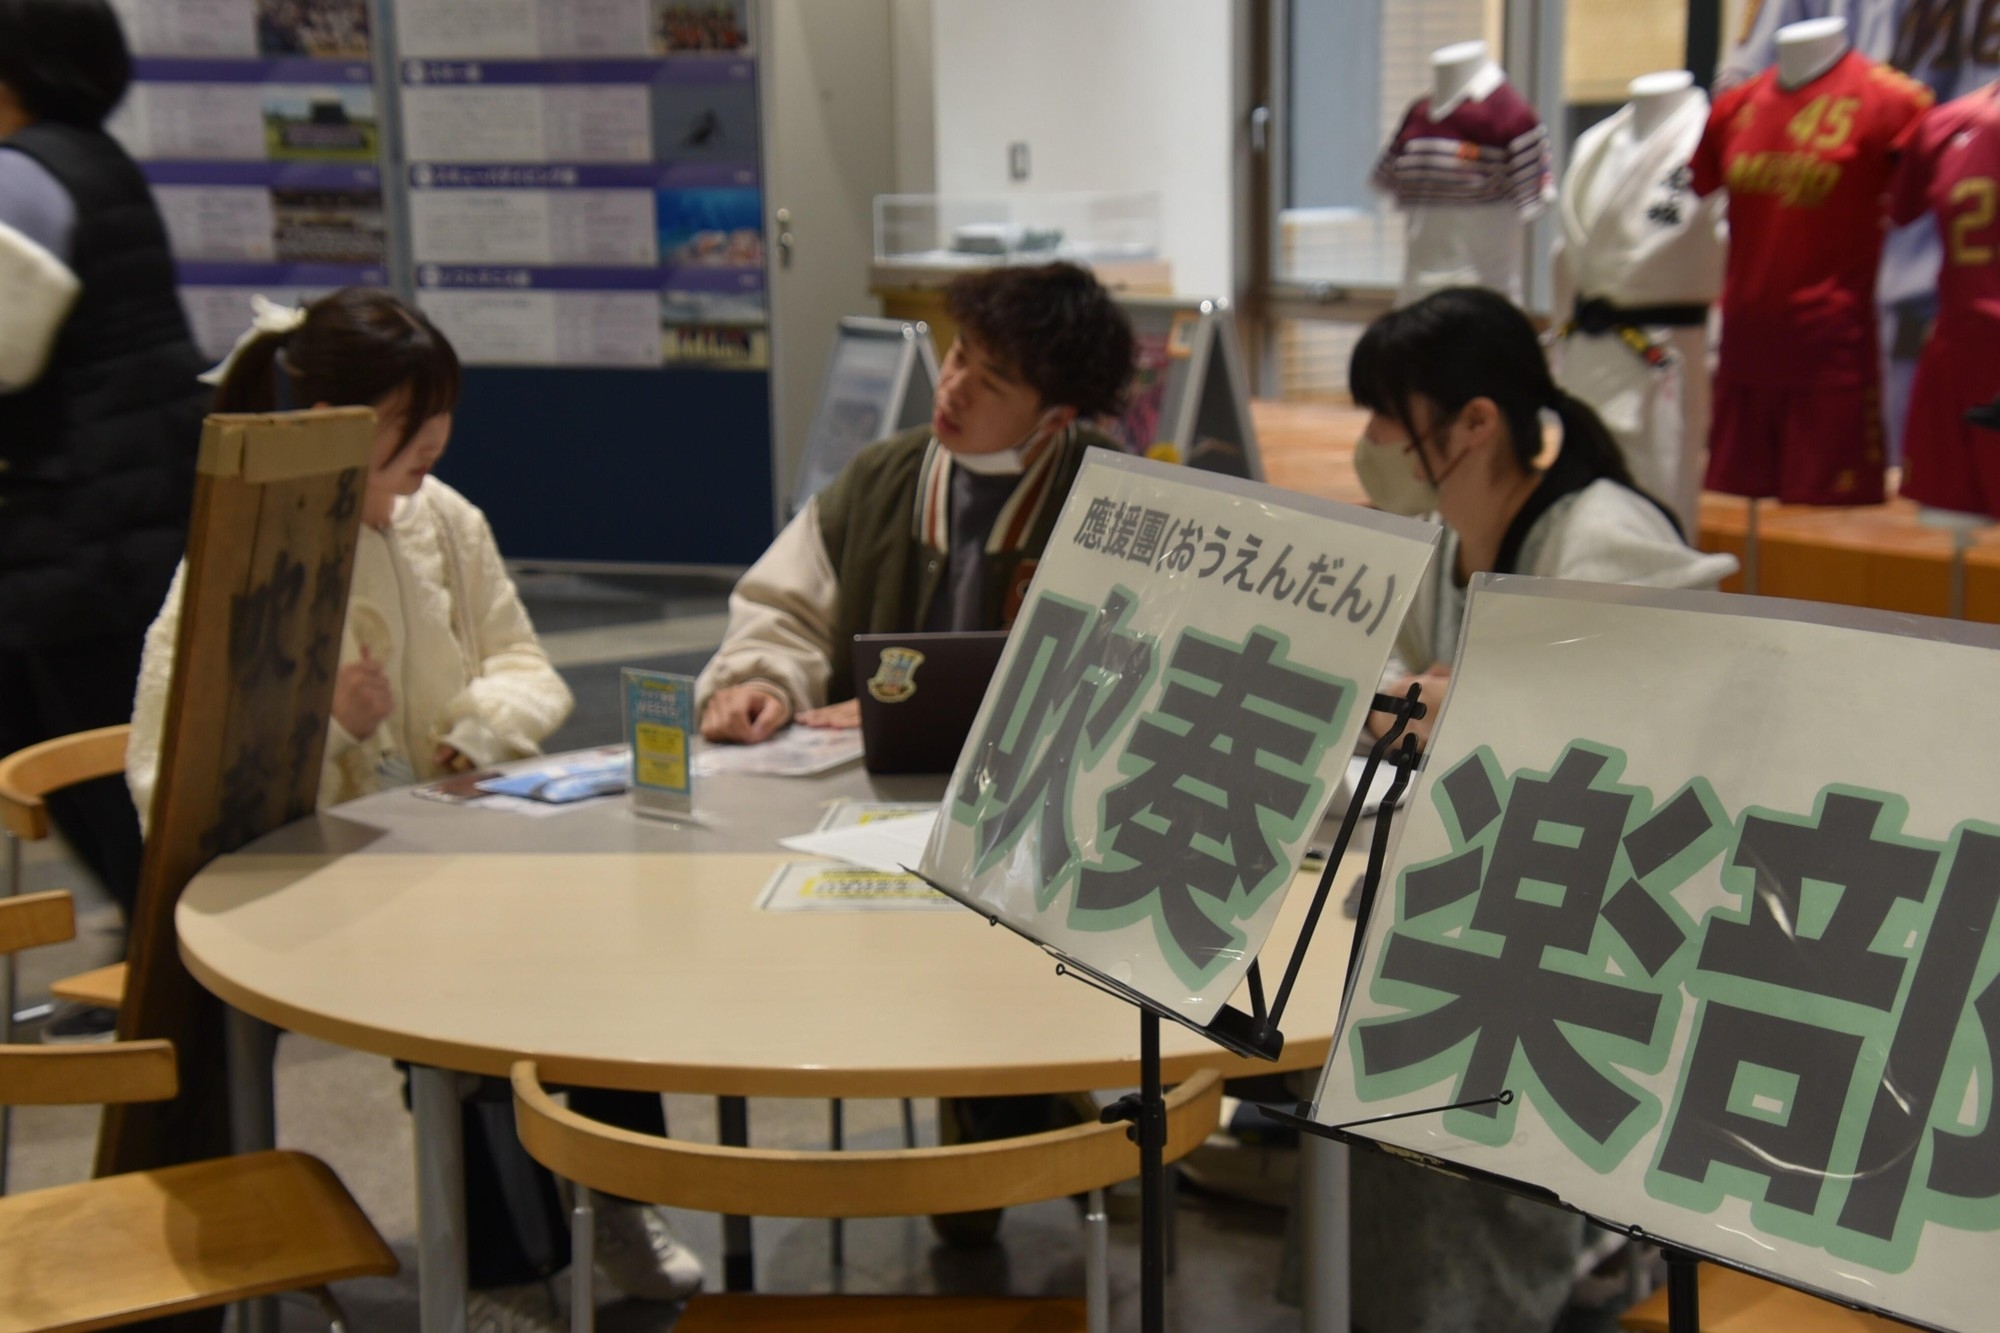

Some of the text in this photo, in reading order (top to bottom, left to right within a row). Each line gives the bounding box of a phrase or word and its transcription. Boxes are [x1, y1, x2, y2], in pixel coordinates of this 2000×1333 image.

[1786, 94, 1861, 150] 45
[1072, 495, 1397, 637] 應援團(おうえんだん)
[955, 588, 1348, 976] 吹奏
[1357, 744, 2000, 1245] 楽部
